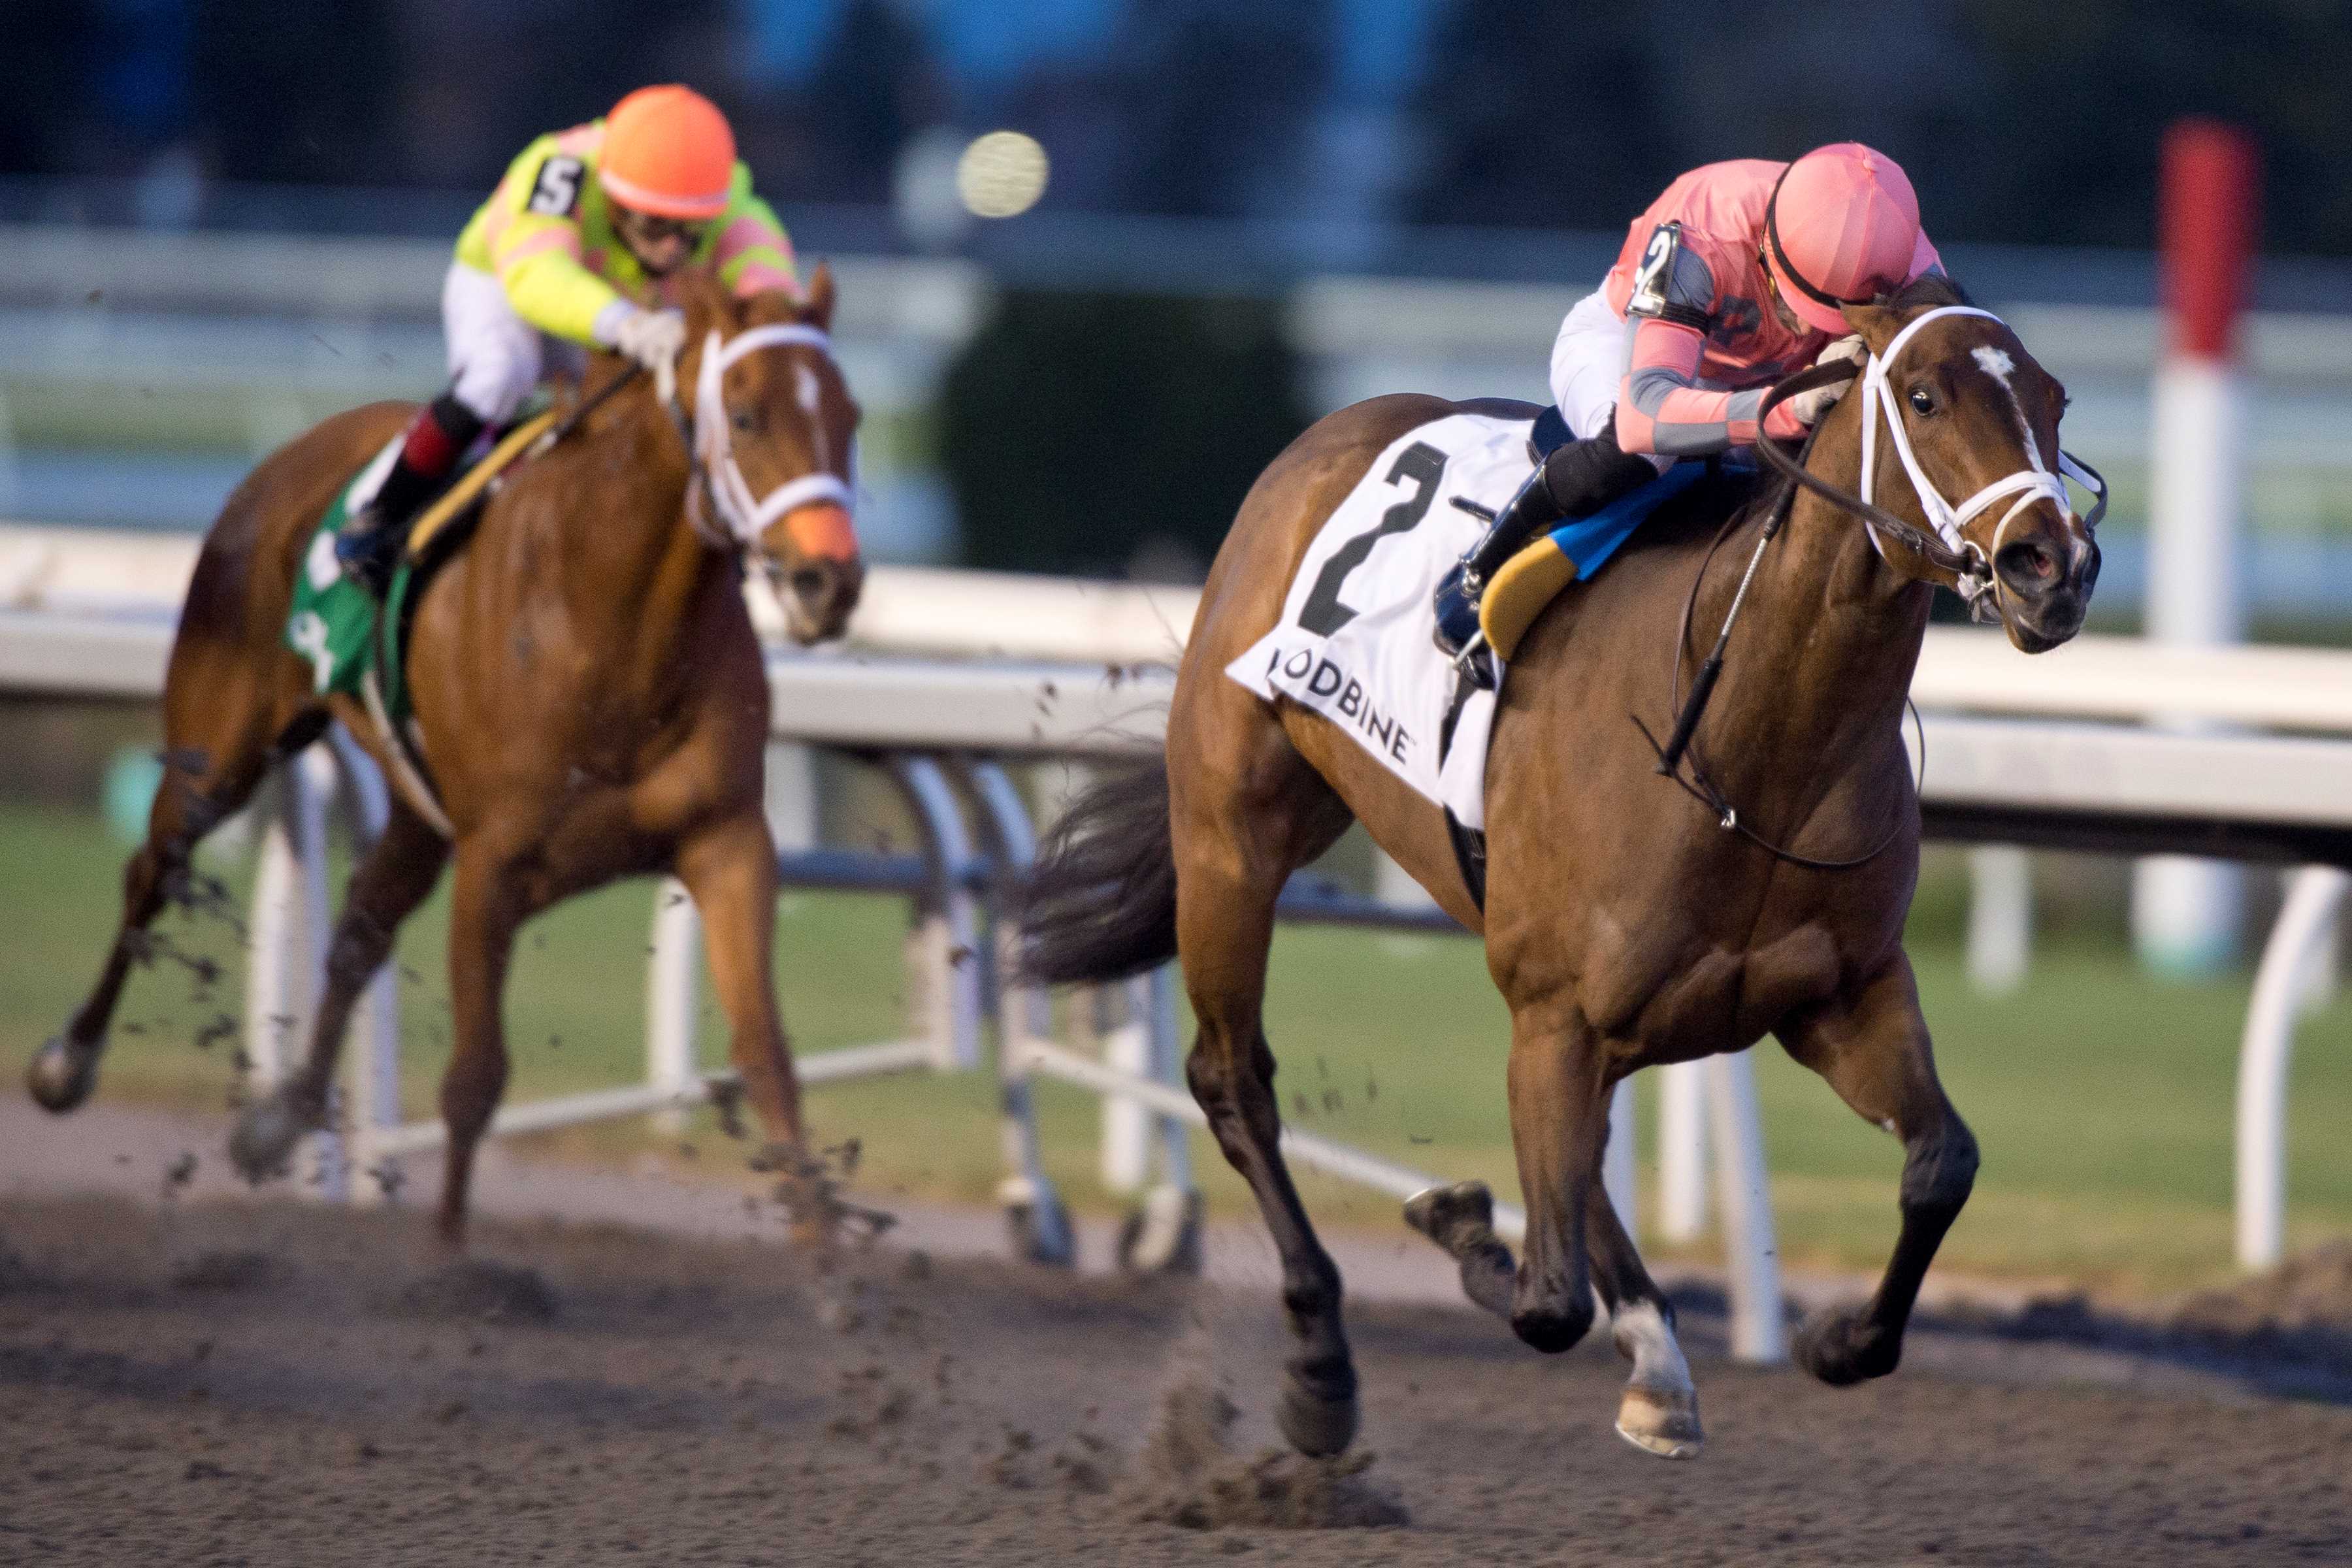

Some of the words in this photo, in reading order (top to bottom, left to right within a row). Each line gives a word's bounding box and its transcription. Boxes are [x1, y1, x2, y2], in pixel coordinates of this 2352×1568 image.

[532, 158, 581, 214] 5
[1631, 231, 1671, 310] 2
[1298, 440, 1450, 638] 2
[1266, 647, 1410, 765] ODBINE
